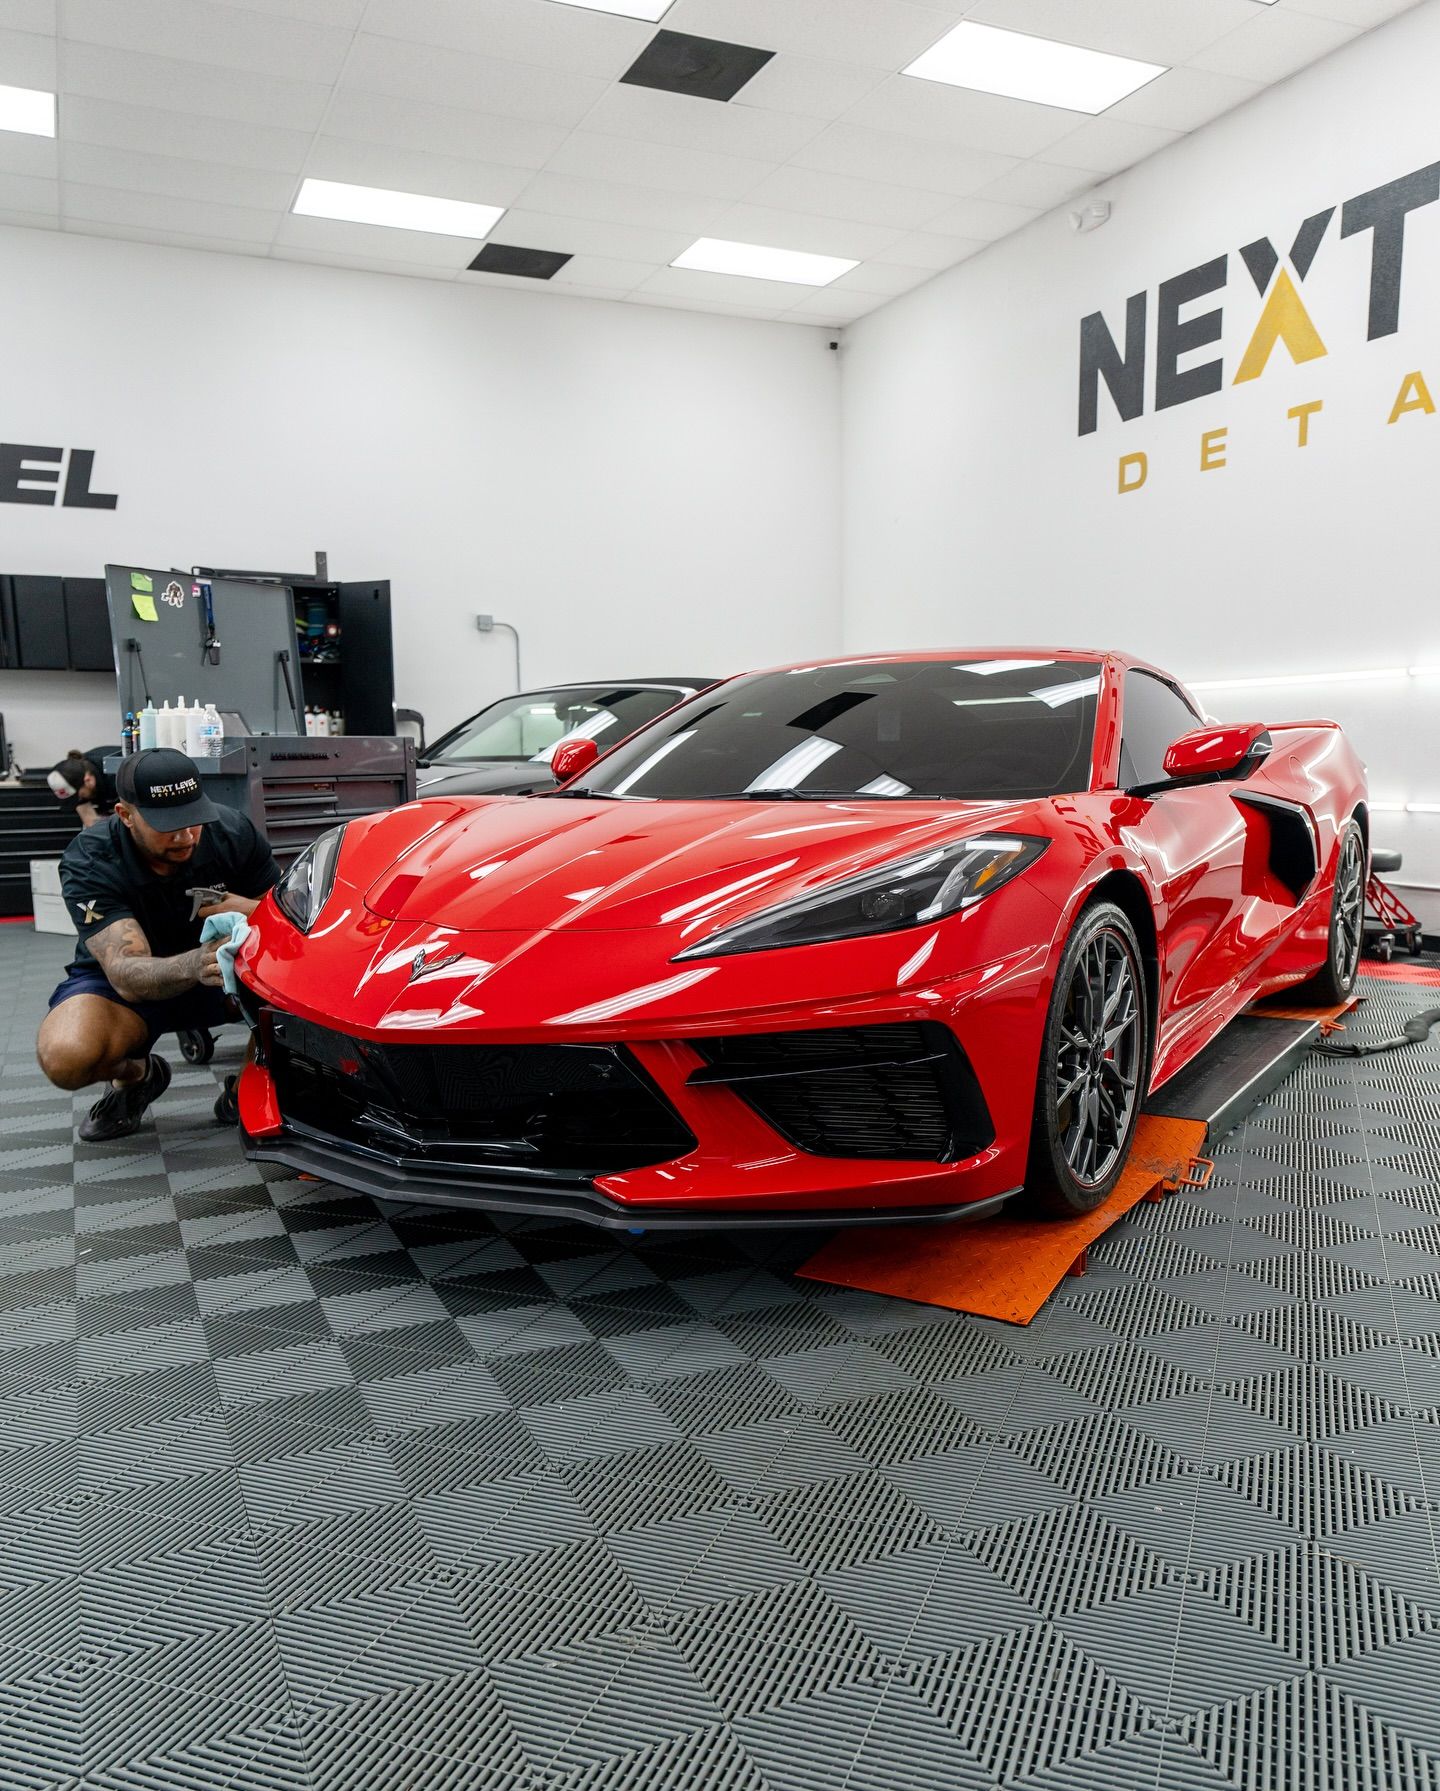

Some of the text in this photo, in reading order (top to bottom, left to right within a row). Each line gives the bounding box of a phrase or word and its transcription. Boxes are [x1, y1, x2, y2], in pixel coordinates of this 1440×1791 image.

[1078, 160, 1440, 437] NEXT
[0, 443, 118, 510] EL
[150, 777, 197, 794] NEXT LEVEL
